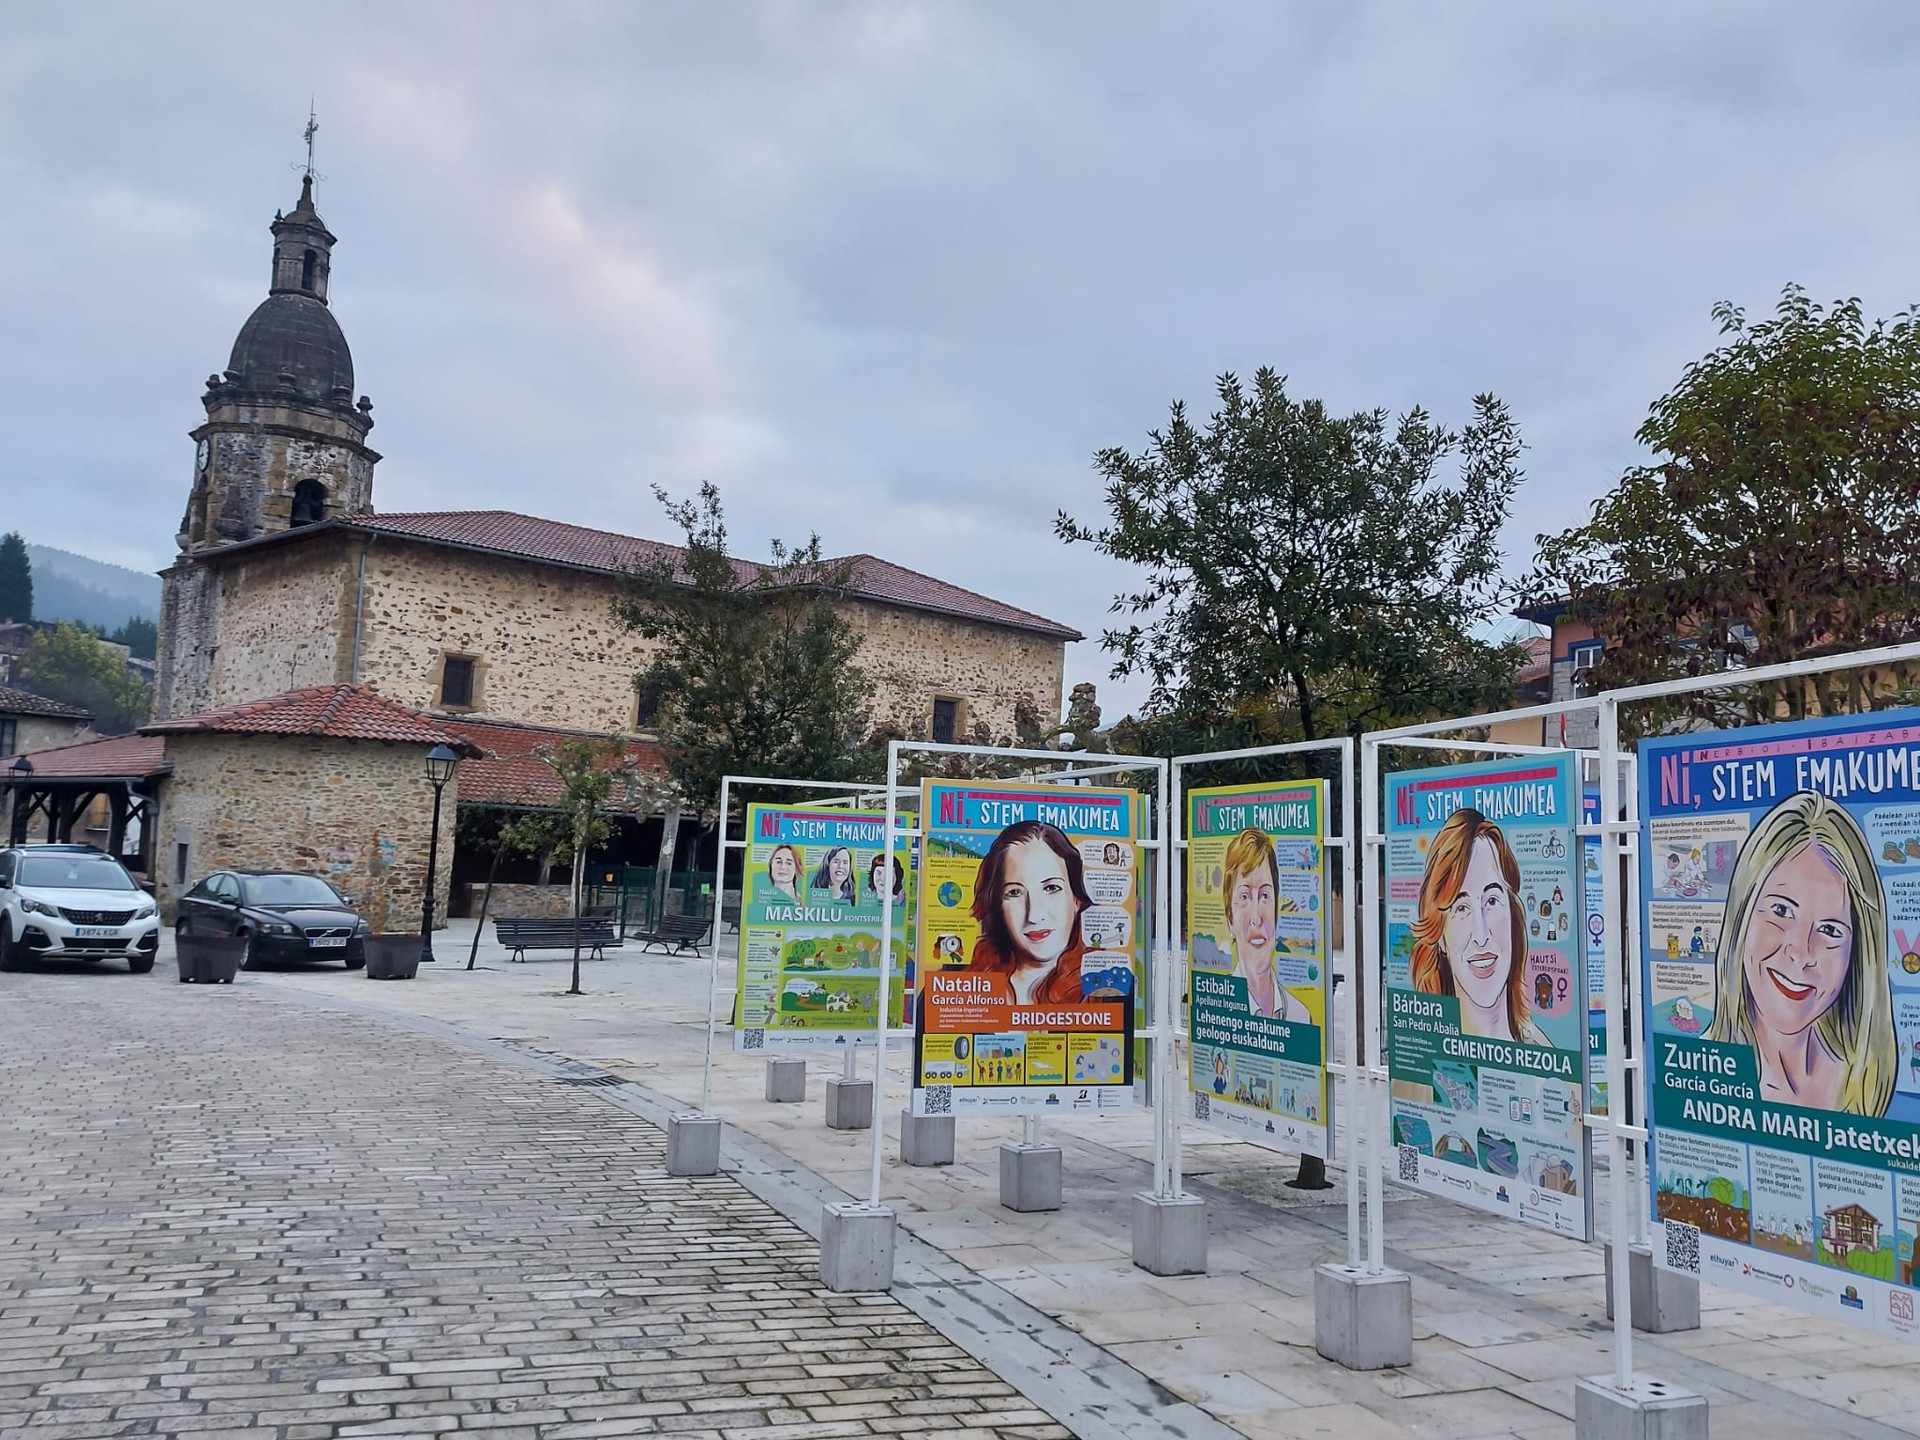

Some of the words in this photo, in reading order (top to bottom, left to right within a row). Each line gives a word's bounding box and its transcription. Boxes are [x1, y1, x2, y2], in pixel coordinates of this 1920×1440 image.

[1660, 750, 1702, 810] Ni,
[1711, 759, 1776, 802] STEM
[1795, 747, 1920, 798] EMAKUME
[940, 791, 972, 829] Ni,
[980, 801, 1024, 827] STEM
[1037, 804, 1120, 831] EMAKUMEA
[1397, 784, 1421, 828] Ni,
[1427, 790, 1465, 822] STEM
[1474, 784, 1556, 820] EMAKUMEA
[1219, 806, 1246, 832] STEM
[1253, 803, 1310, 831] EMAKUMEA
[792, 820, 826, 839] STEM
[765, 905, 842, 923] MASKILU
[932, 976, 991, 992] Natalia
[1195, 976, 1236, 997] Estibaliz
[931, 994, 964, 1005] García
[966, 994, 1005, 1005] Alfonso
[1195, 995, 1223, 1009] Apellaniz
[1223, 998, 1248, 1012] Ingunza
[1393, 993, 1443, 1018] Bárbara
[1011, 1012, 1111, 1026] BRIDGESTONE
[1196, 1010, 1243, 1030] Lehenengo
[1244, 1018, 1291, 1038] emakume
[1393, 1017, 1408, 1029] San
[1408, 1019, 1432, 1033] Pedro
[1433, 1023, 1460, 1037] Abalia
[1196, 1026, 1231, 1043] geologo
[1232, 1032, 1285, 1053] euskalduna
[1442, 1037, 1512, 1065] CEMENTOS
[1515, 1048, 1573, 1075] REZOLA
[1663, 1042, 1738, 1077] Zuriñe
[1664, 1072, 1707, 1093] García
[1708, 1079, 1755, 1101] García
[1682, 1098, 1757, 1132] ANDRA
[1761, 1110, 1820, 1142] MARI
[1774, 1180, 1790, 1189] dugu
[1818, 1172, 1841, 1182] gustura
[1841, 1176, 1852, 1184] eta
[1852, 1177, 1884, 1191] itzultzeko
[1818, 1180, 1837, 1190] gogoz
[1709, 1253, 1735, 1267] elhuyar
